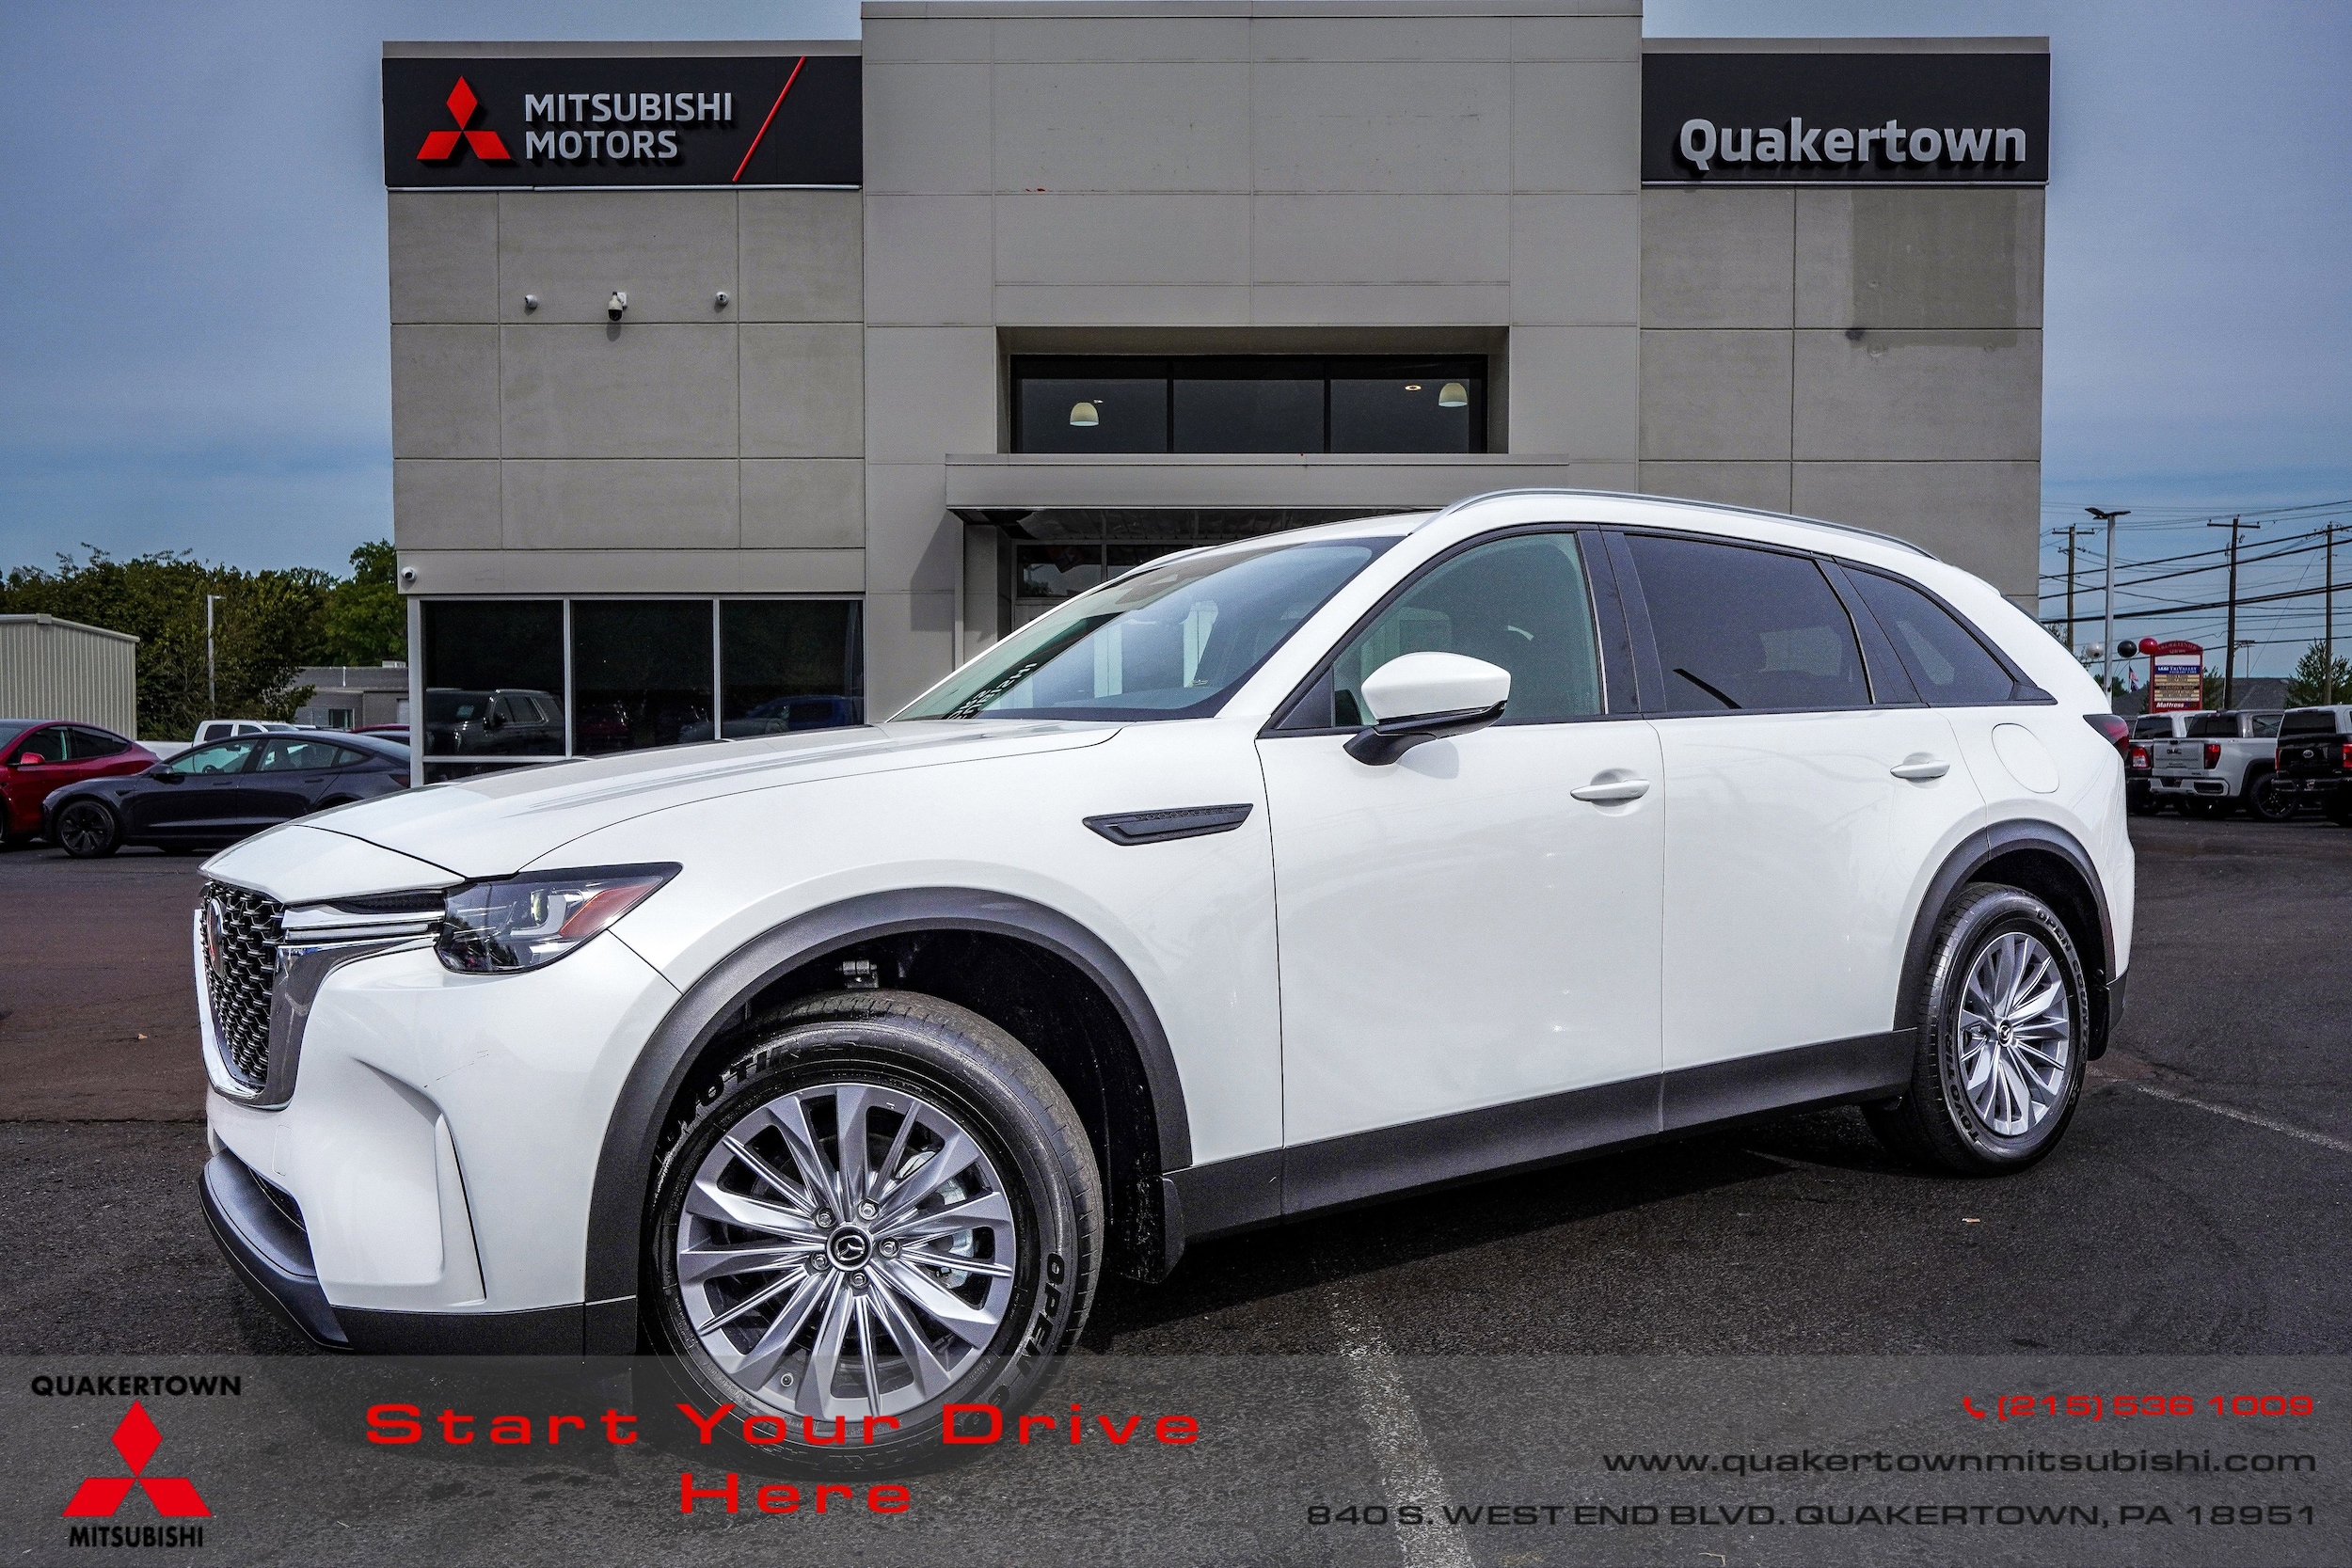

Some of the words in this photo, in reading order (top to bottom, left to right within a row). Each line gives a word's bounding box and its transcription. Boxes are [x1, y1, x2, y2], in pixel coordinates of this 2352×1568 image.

[525, 92, 732, 122] MITSUBISHI
[525, 130, 677, 159] MOTORS
[1679, 117, 2026, 171] Quakertown
